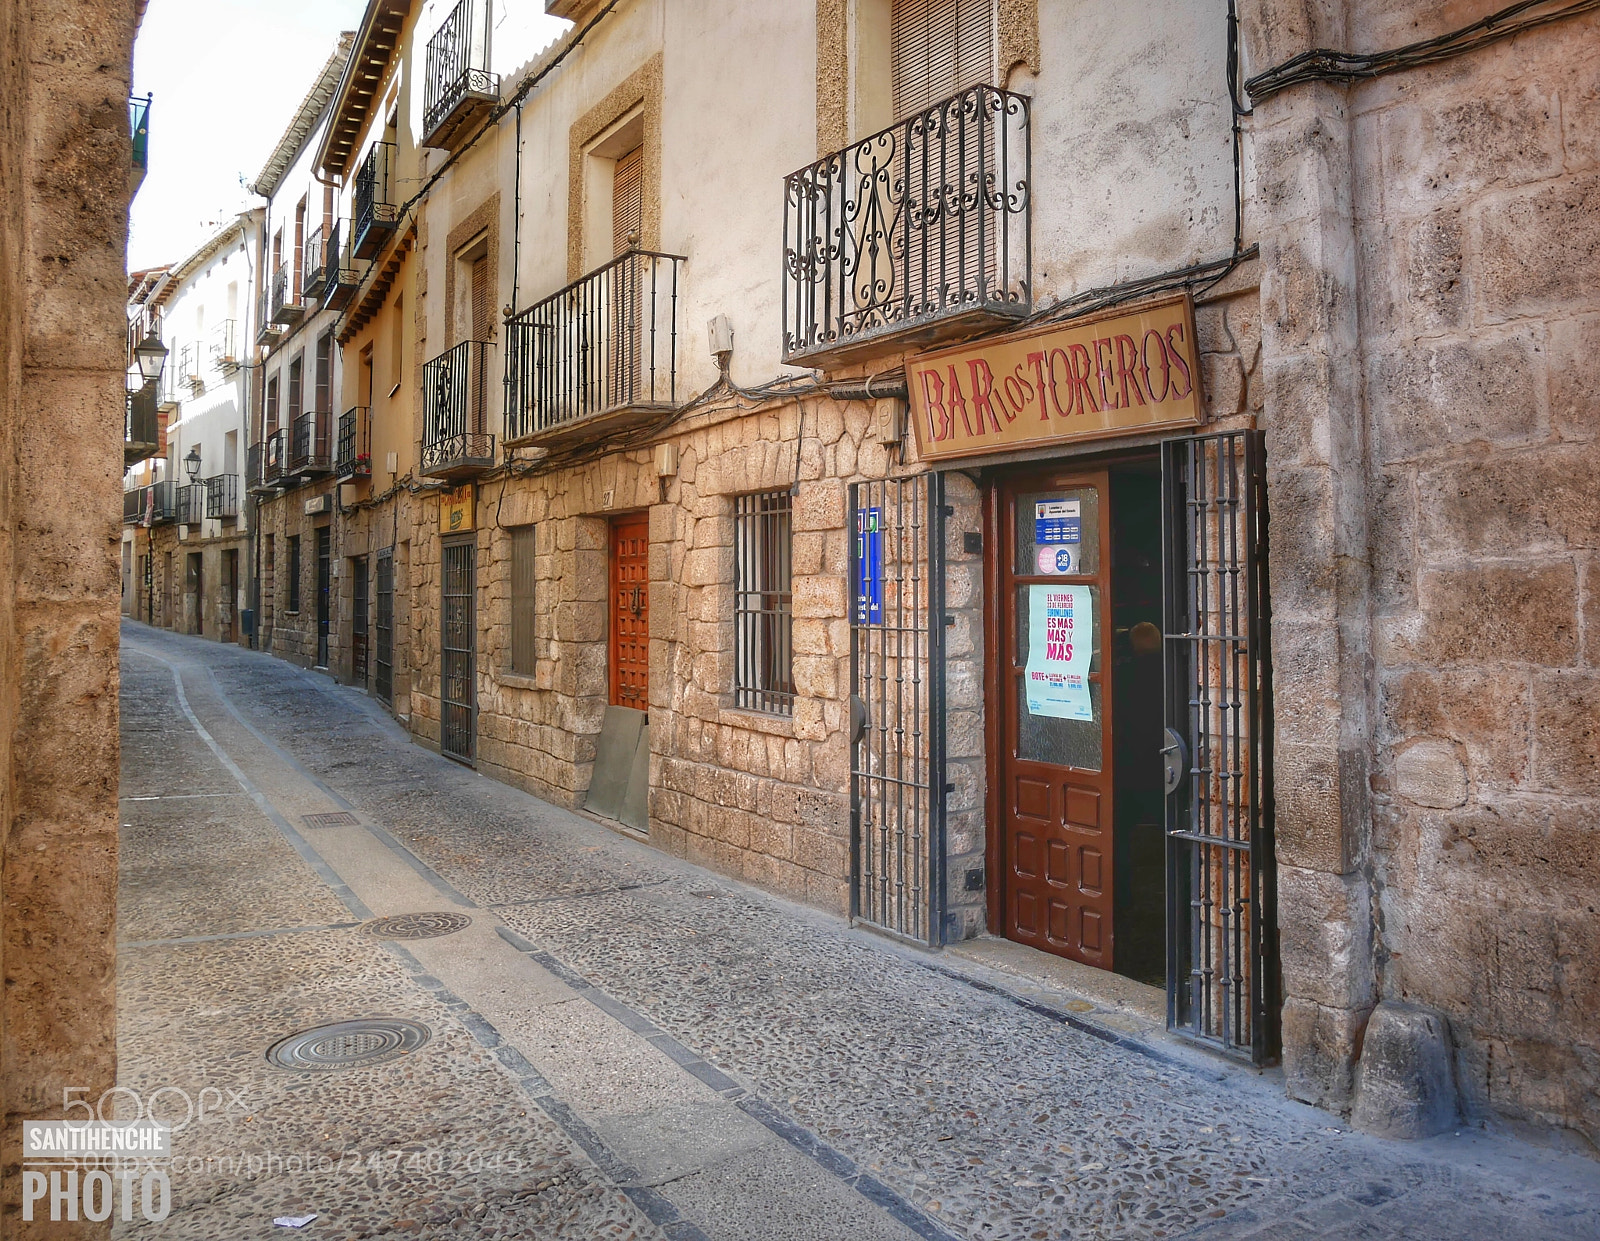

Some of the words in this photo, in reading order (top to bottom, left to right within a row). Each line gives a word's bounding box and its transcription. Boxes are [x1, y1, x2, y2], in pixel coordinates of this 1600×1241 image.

[918, 358, 1001, 443] BAR
[993, 363, 1035, 424] LOS
[1027, 323, 1193, 421] TOREROS
[1057, 554, 1068, 562] +18
[1053, 594, 1073, 602] VIERNES
[1047, 618, 1056, 628] ES
[1068, 632, 1073, 642] Y
[1046, 643, 1073, 661] MÁS
[1032, 672, 1045, 680] BOTE
